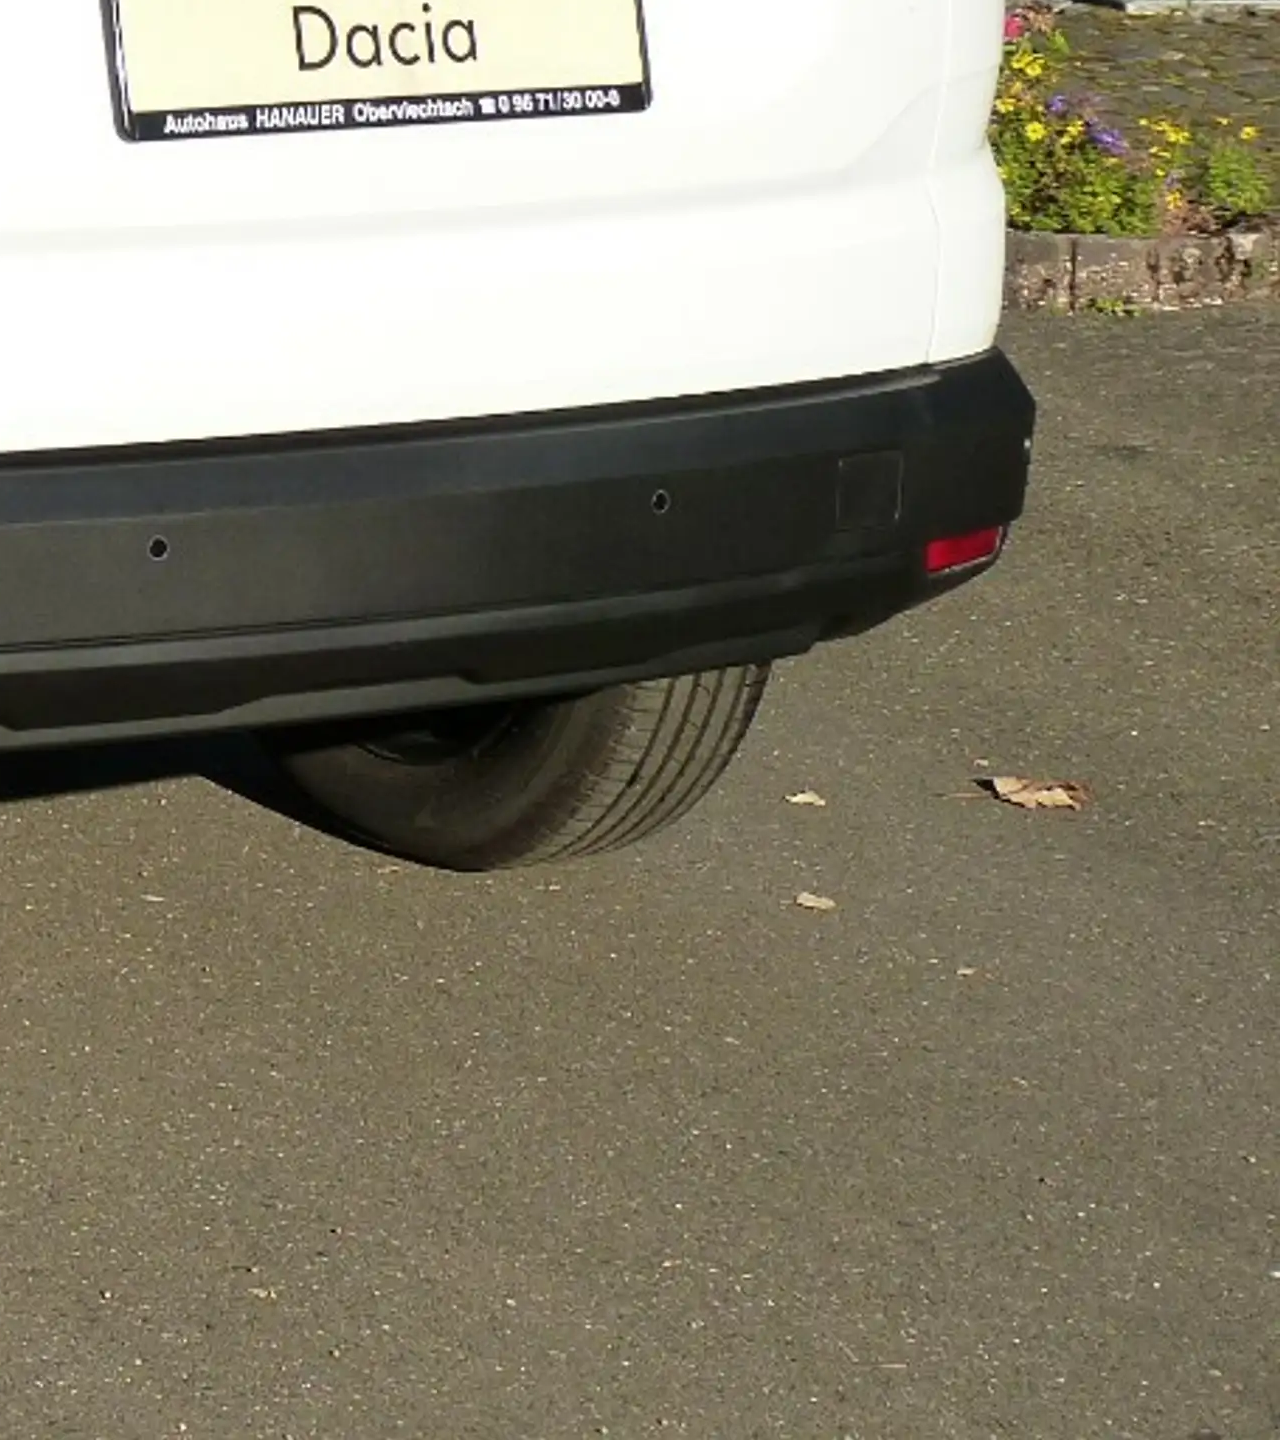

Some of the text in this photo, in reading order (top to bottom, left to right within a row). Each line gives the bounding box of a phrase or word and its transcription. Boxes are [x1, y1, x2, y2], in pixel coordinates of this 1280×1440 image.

[292, 2, 479, 72] Dacia
[163, 112, 249, 136] Autohaus
[255, 105, 344, 130] HANAUER
[353, 98, 474, 124] Oberviechtach
